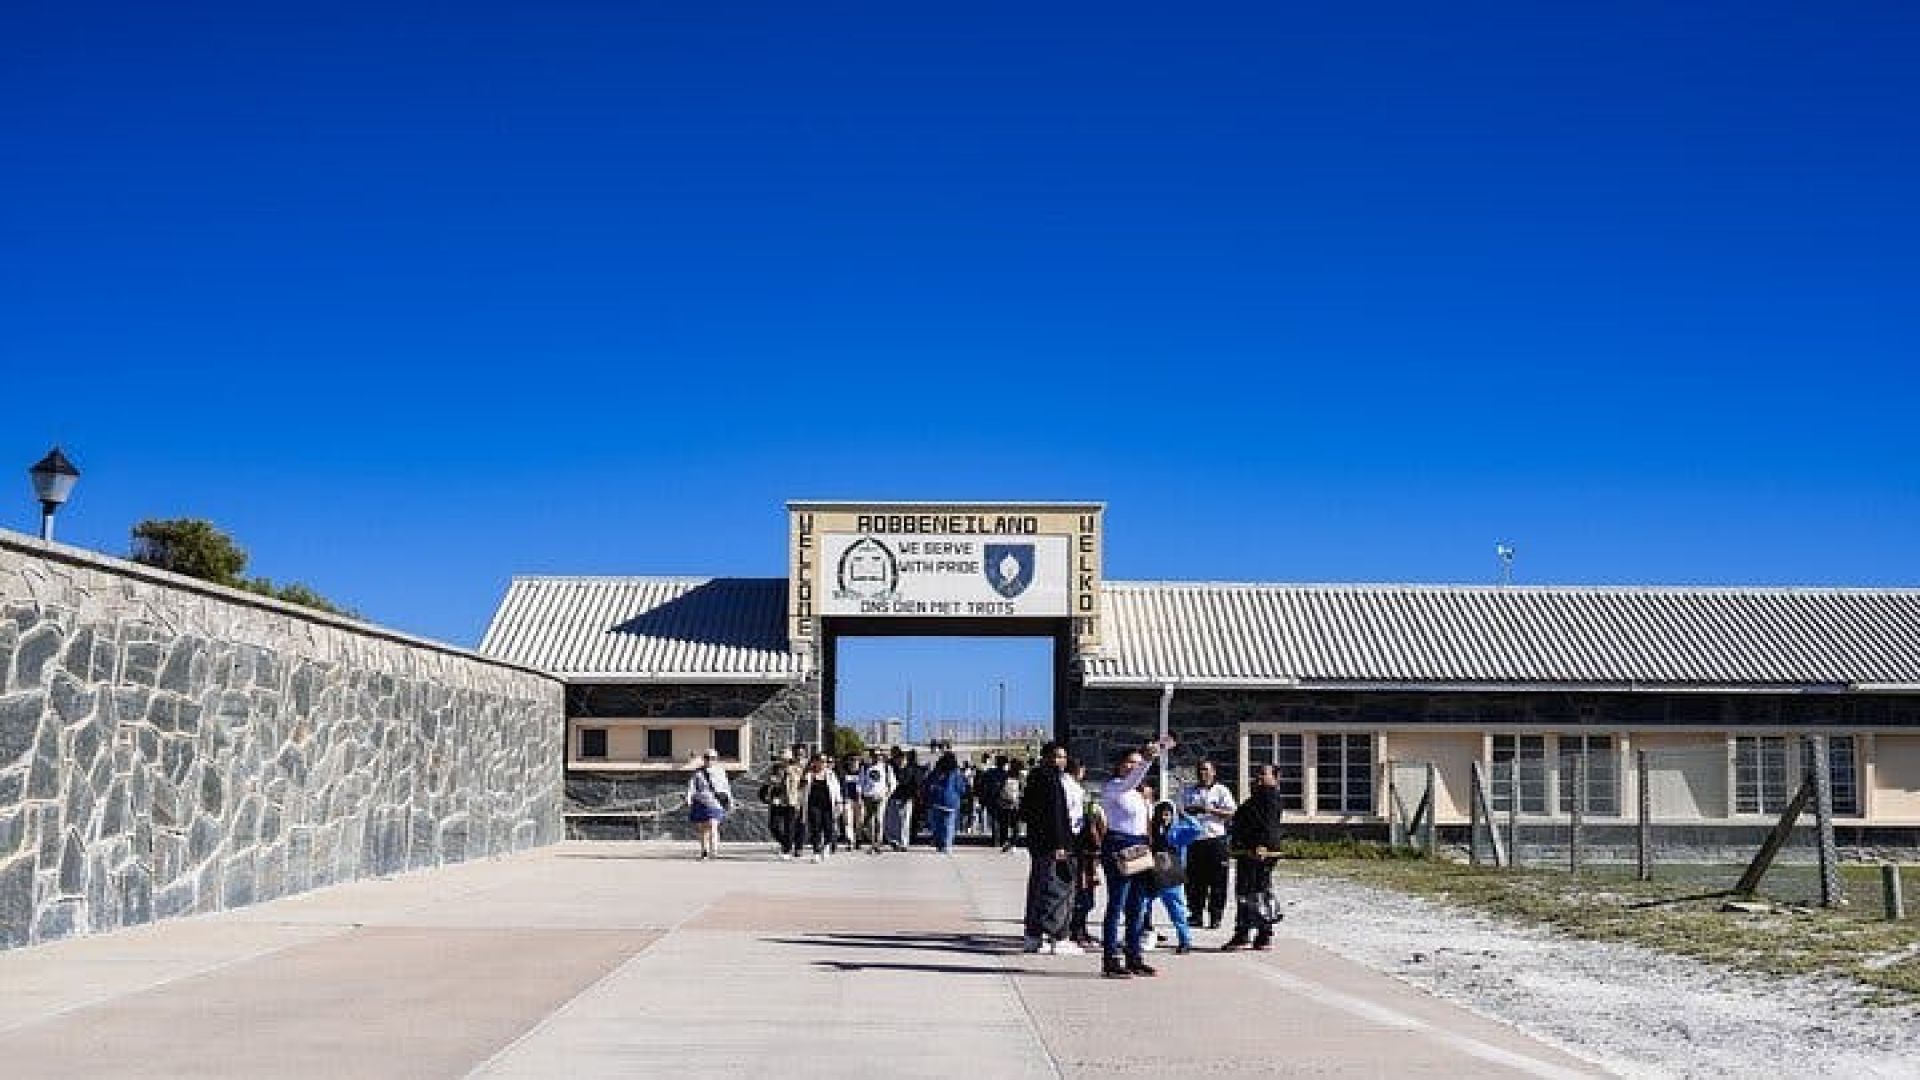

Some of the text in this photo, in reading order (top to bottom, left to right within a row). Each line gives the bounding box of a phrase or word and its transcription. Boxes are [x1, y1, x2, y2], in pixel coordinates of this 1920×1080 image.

[857, 515, 1038, 534] ROBBENEILAND
[898, 541, 974, 555] WE SERVE
[897, 561, 980, 575] WITH PRIDE
[1079, 514, 1094, 636] WELKOM
[860, 600, 889, 614] ONS
[930, 600, 961, 615] MET
[967, 601, 1015, 615] TROTS
